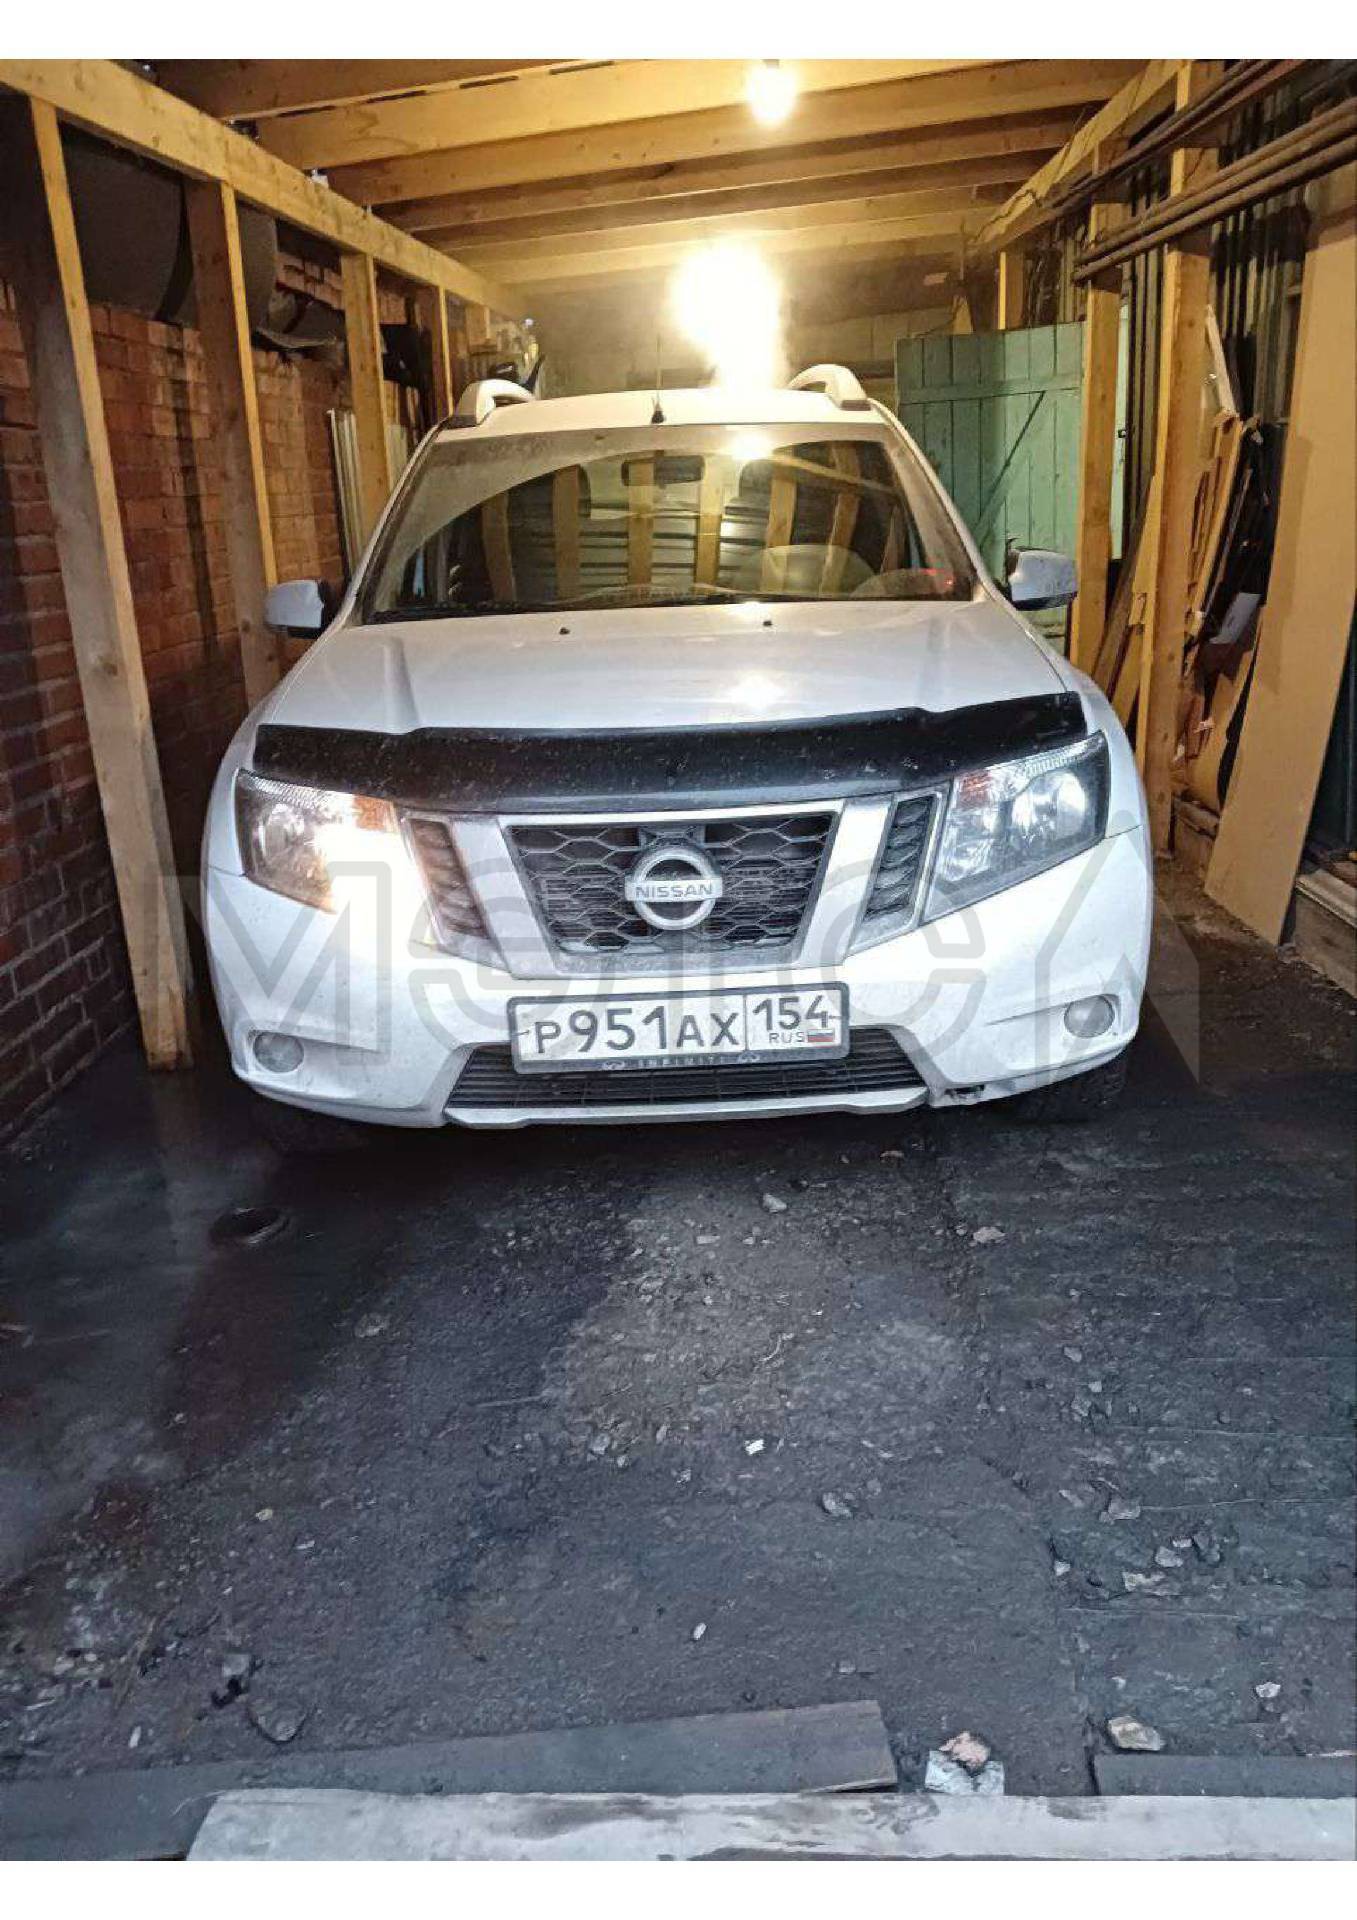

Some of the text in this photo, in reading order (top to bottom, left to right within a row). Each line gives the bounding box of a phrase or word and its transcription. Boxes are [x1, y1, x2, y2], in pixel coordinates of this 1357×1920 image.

[635, 881, 713, 898] NISSAN
[534, 994, 829, 1054] Р951АХ 154
[769, 1029, 806, 1044] RUS
